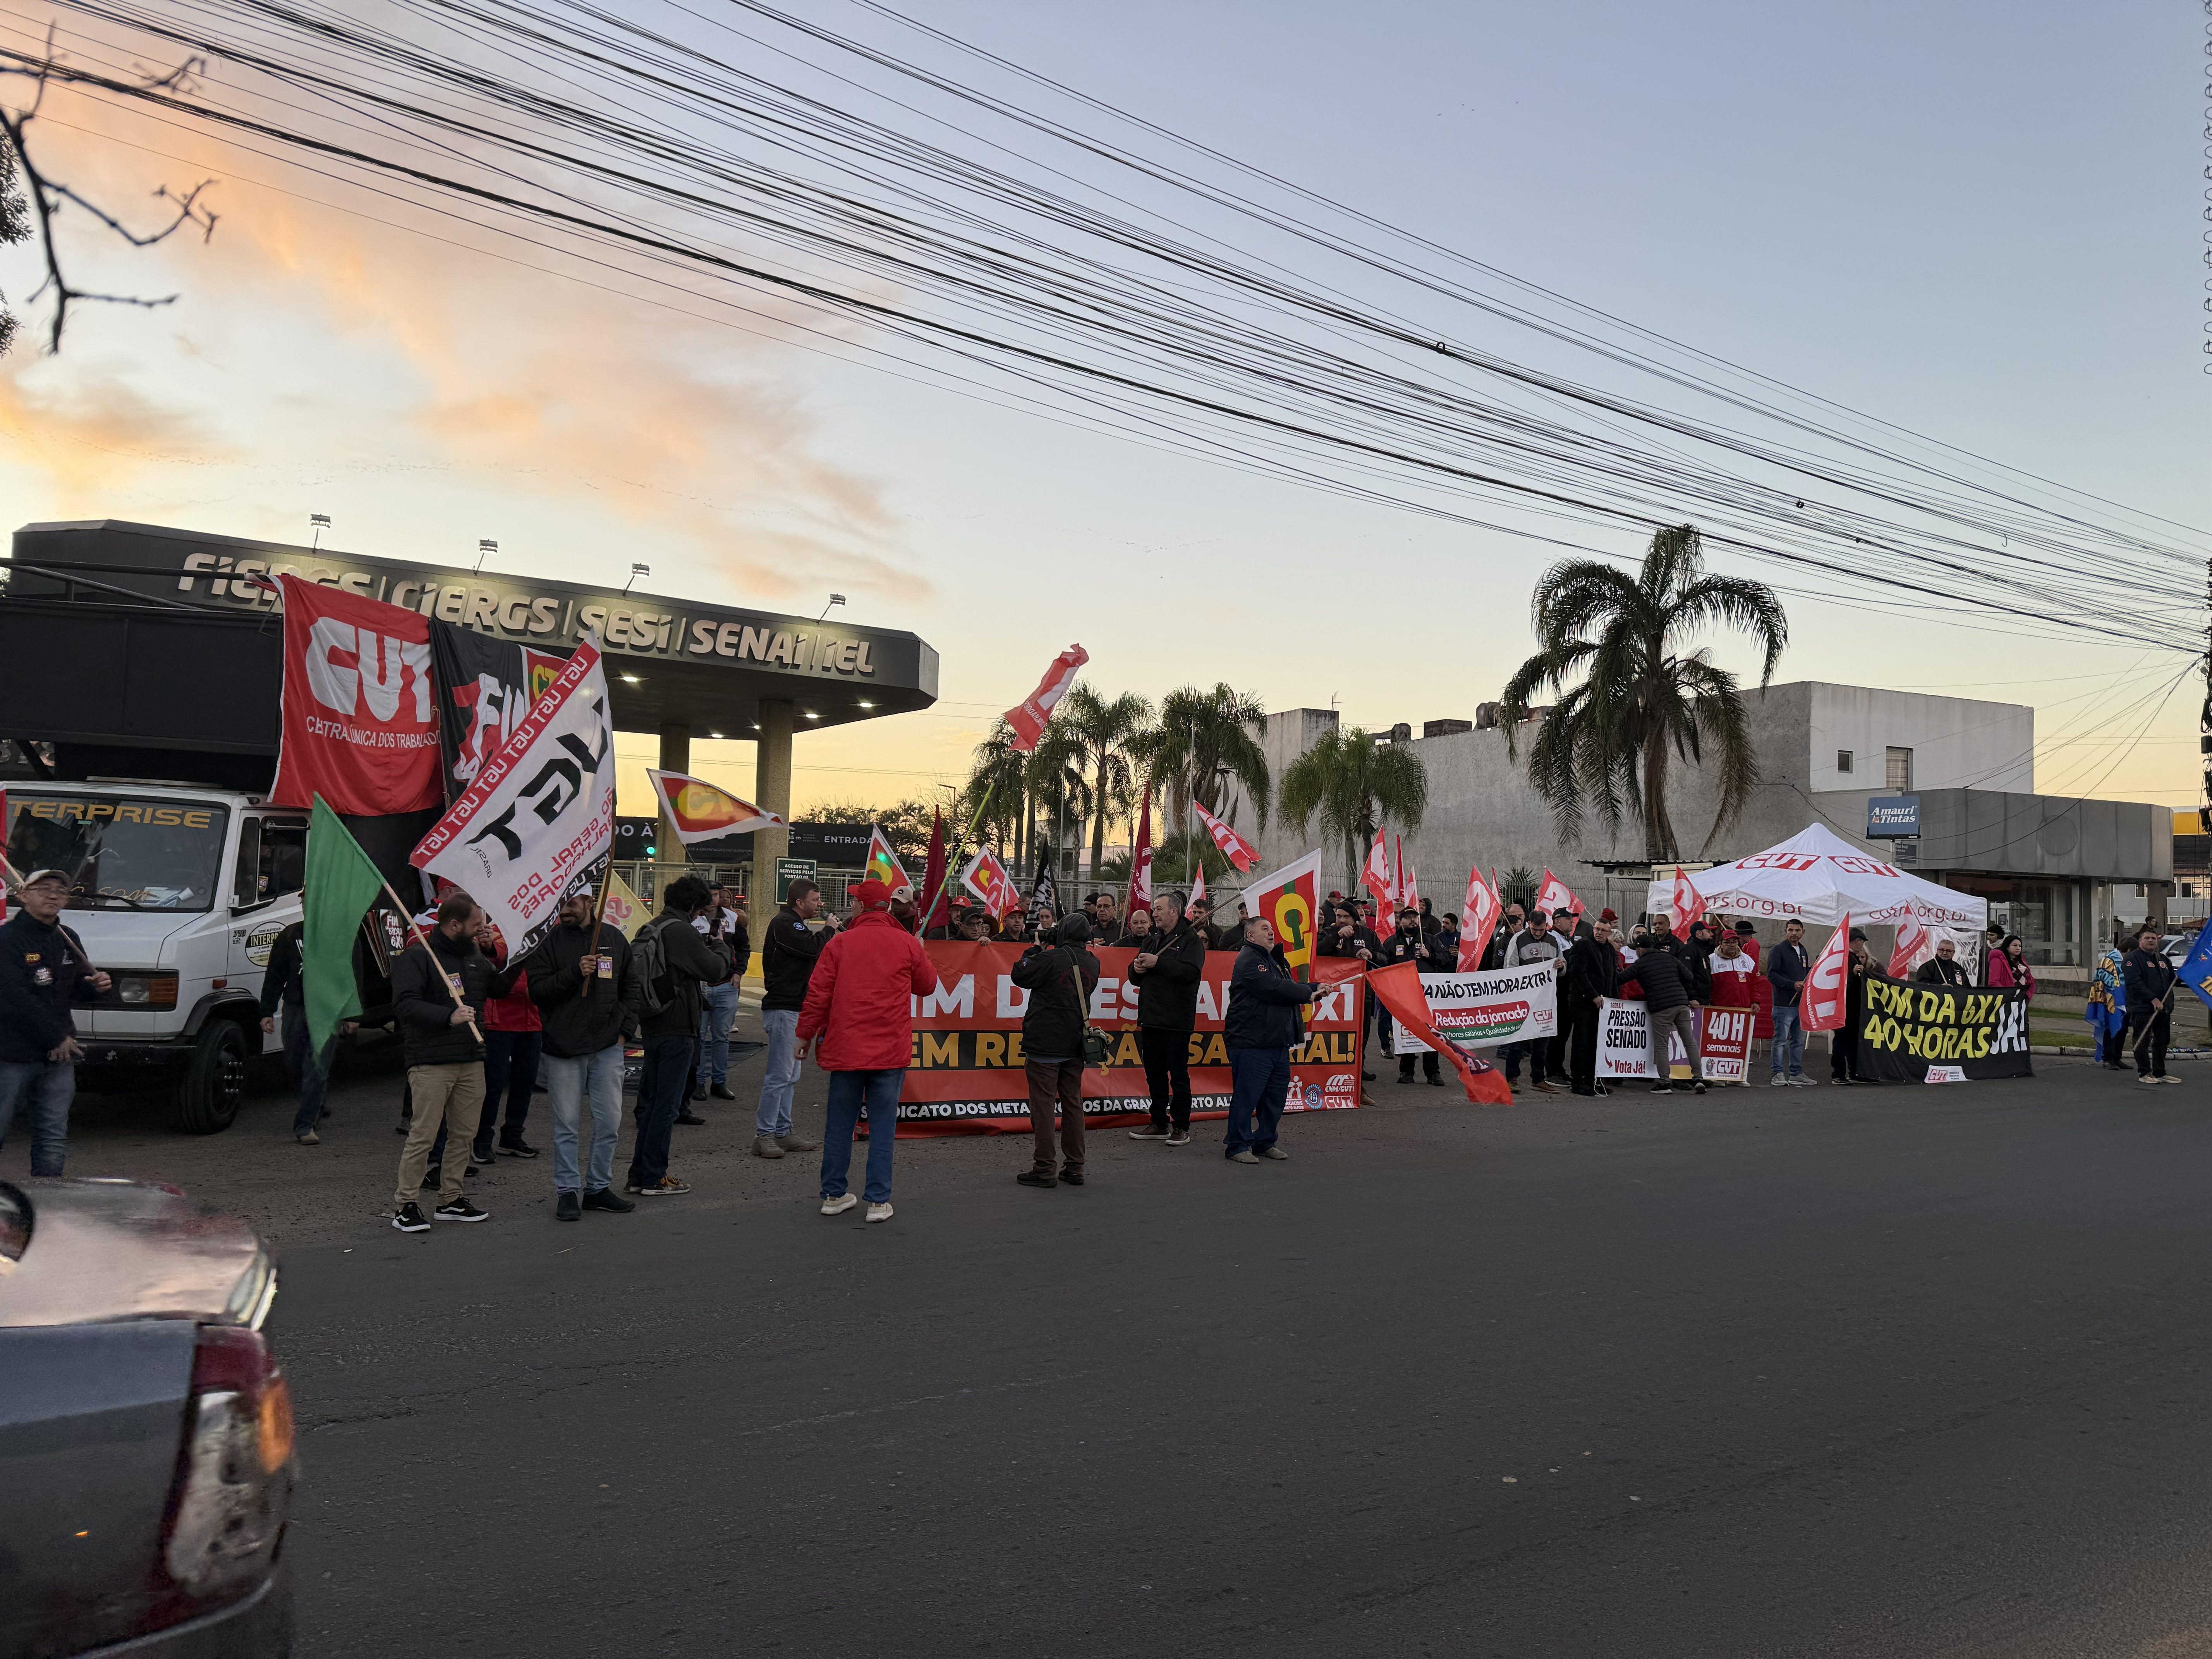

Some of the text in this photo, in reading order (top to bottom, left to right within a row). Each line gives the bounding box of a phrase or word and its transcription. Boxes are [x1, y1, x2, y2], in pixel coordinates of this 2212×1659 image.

[306, 617, 431, 722] CUT
[378, 732, 394, 747] DOS
[8, 800, 212, 829] TERPRISE
[1871, 806, 1915, 815] Amauri
[1880, 815, 1915, 823] Tintas
[824, 836, 872, 844] ENTRADA
[1742, 854, 1819, 870] CUT
[1834, 857, 1895, 877] CUT
[1434, 980, 1465, 998] NÃO
[1463, 981, 1489, 998] TEM
[1491, 978, 1518, 996] HORA
[1866, 978, 1913, 1019] FIM
[1919, 991, 1955, 1024] DA
[1435, 1005, 1528, 1029] Redução da jornada
[1534, 1010, 1552, 1021] CUT
[1607, 1008, 1646, 1027] PRESSÃO
[1486, 1027, 1510, 1036] Qualidade
[1864, 989, 2027, 1059] 40 HORAS JÁ!
[1606, 1028, 1647, 1049] SENADO
[1706, 1042, 1741, 1053] semanais
[1614, 1060, 1645, 1074] Vota Já!
[1717, 1061, 1740, 1073] CUT
[956, 1103, 988, 1115] DOS
[1103, 1099, 1122, 1111] DA
[1326, 1097, 1350, 1108] CUT
